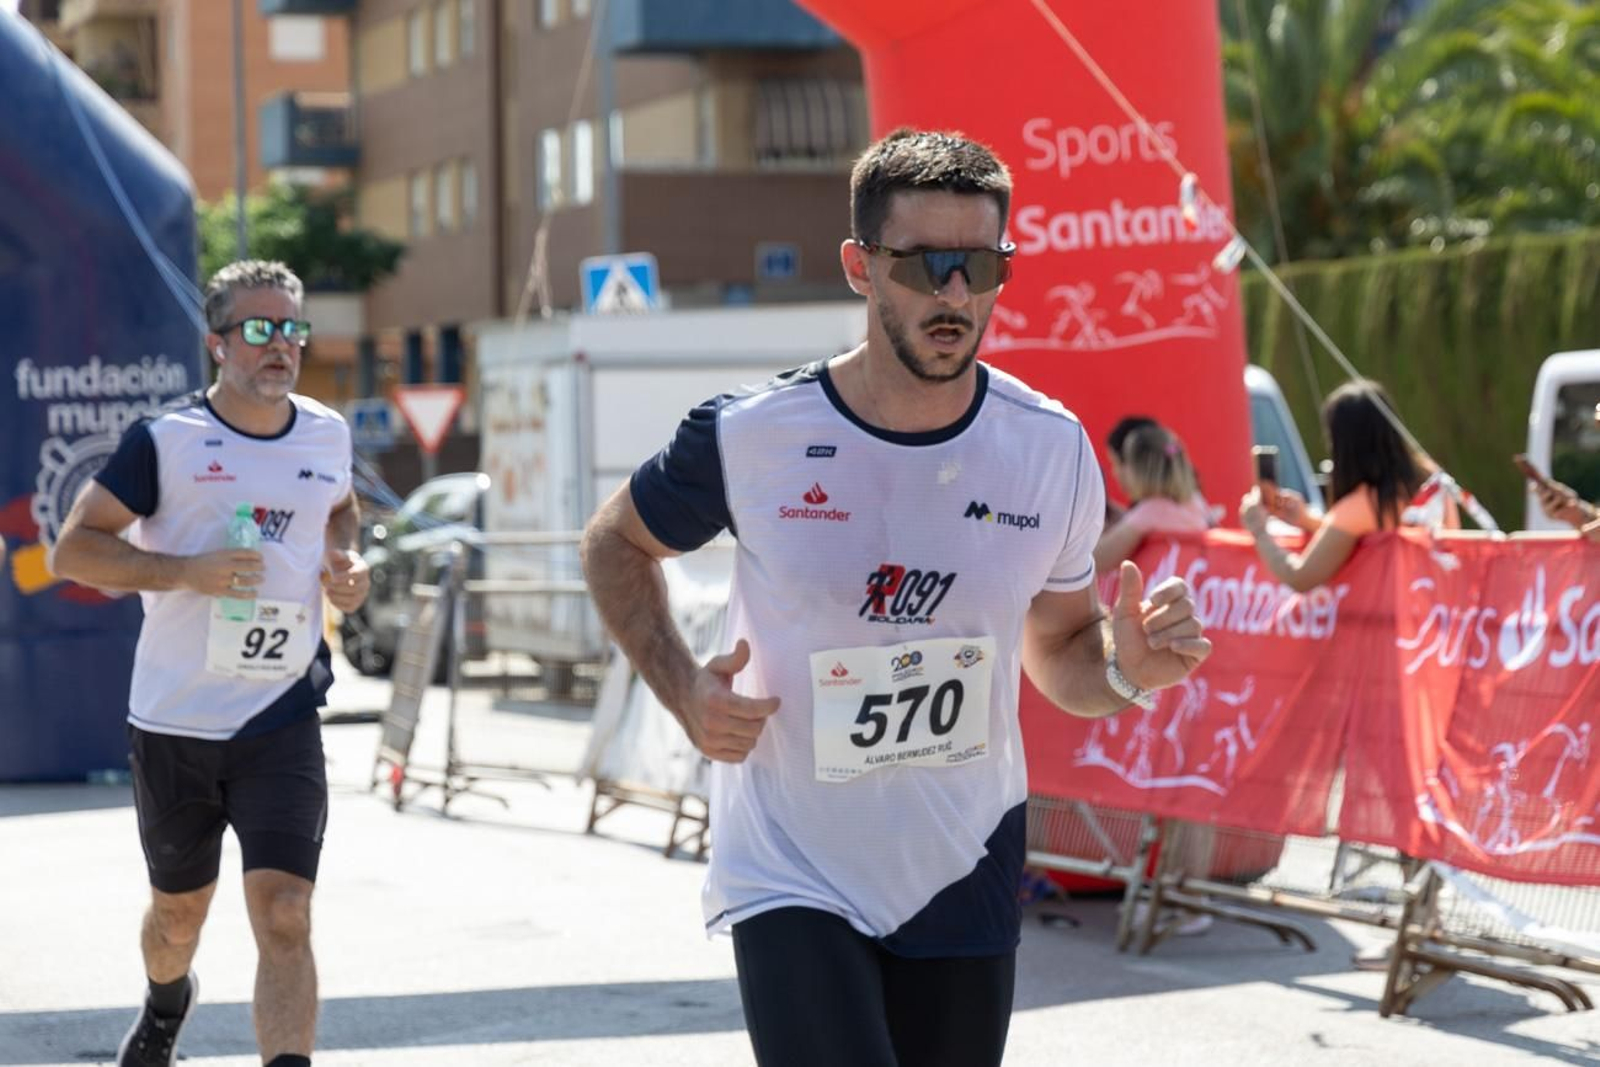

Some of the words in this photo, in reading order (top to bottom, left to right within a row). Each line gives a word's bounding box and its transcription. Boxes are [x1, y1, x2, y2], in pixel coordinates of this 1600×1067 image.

[1022, 117, 1178, 179] Sports
[14, 354, 188, 399] fundación
[779, 506, 851, 522] Santander
[997, 512, 1040, 531] mupol
[241, 627, 290, 660] 92
[850, 679, 964, 748] 570
